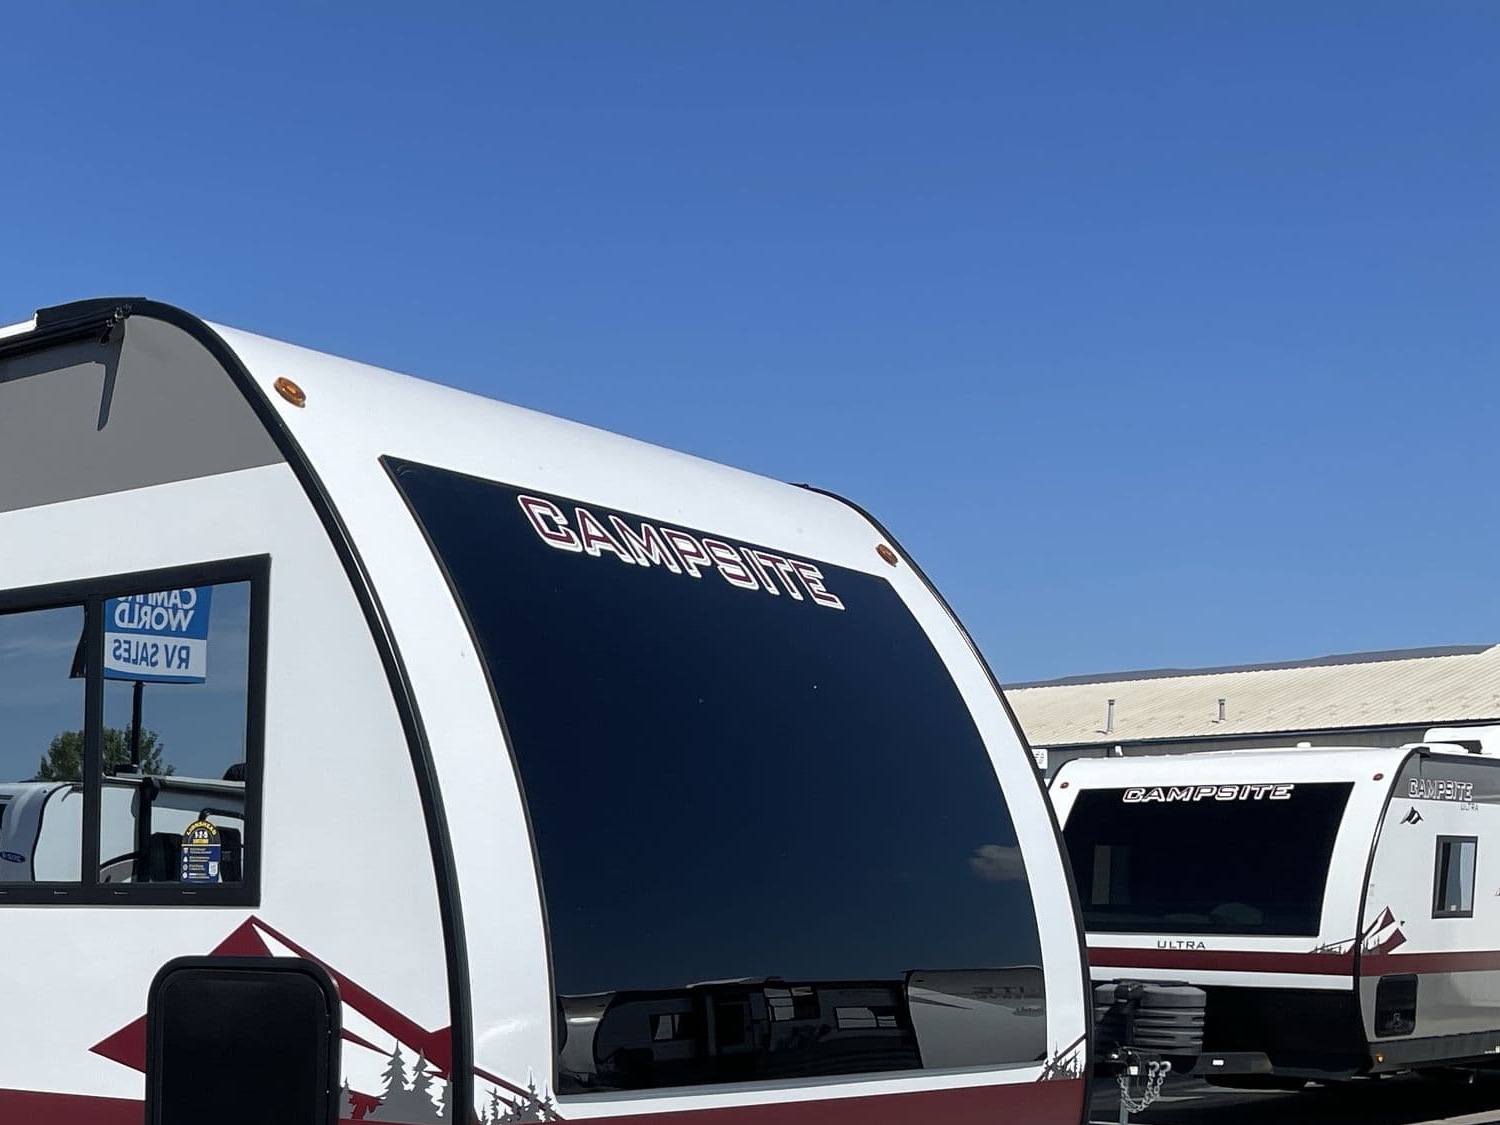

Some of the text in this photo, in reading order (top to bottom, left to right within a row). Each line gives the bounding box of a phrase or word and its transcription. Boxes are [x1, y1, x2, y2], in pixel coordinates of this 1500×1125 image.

[517, 495, 846, 610] CAMPSITE
[1122, 784, 1295, 803] CAMPSITE
[1409, 779, 1473, 801] CAMPSITE
[1157, 940, 1206, 950] ULTRA
